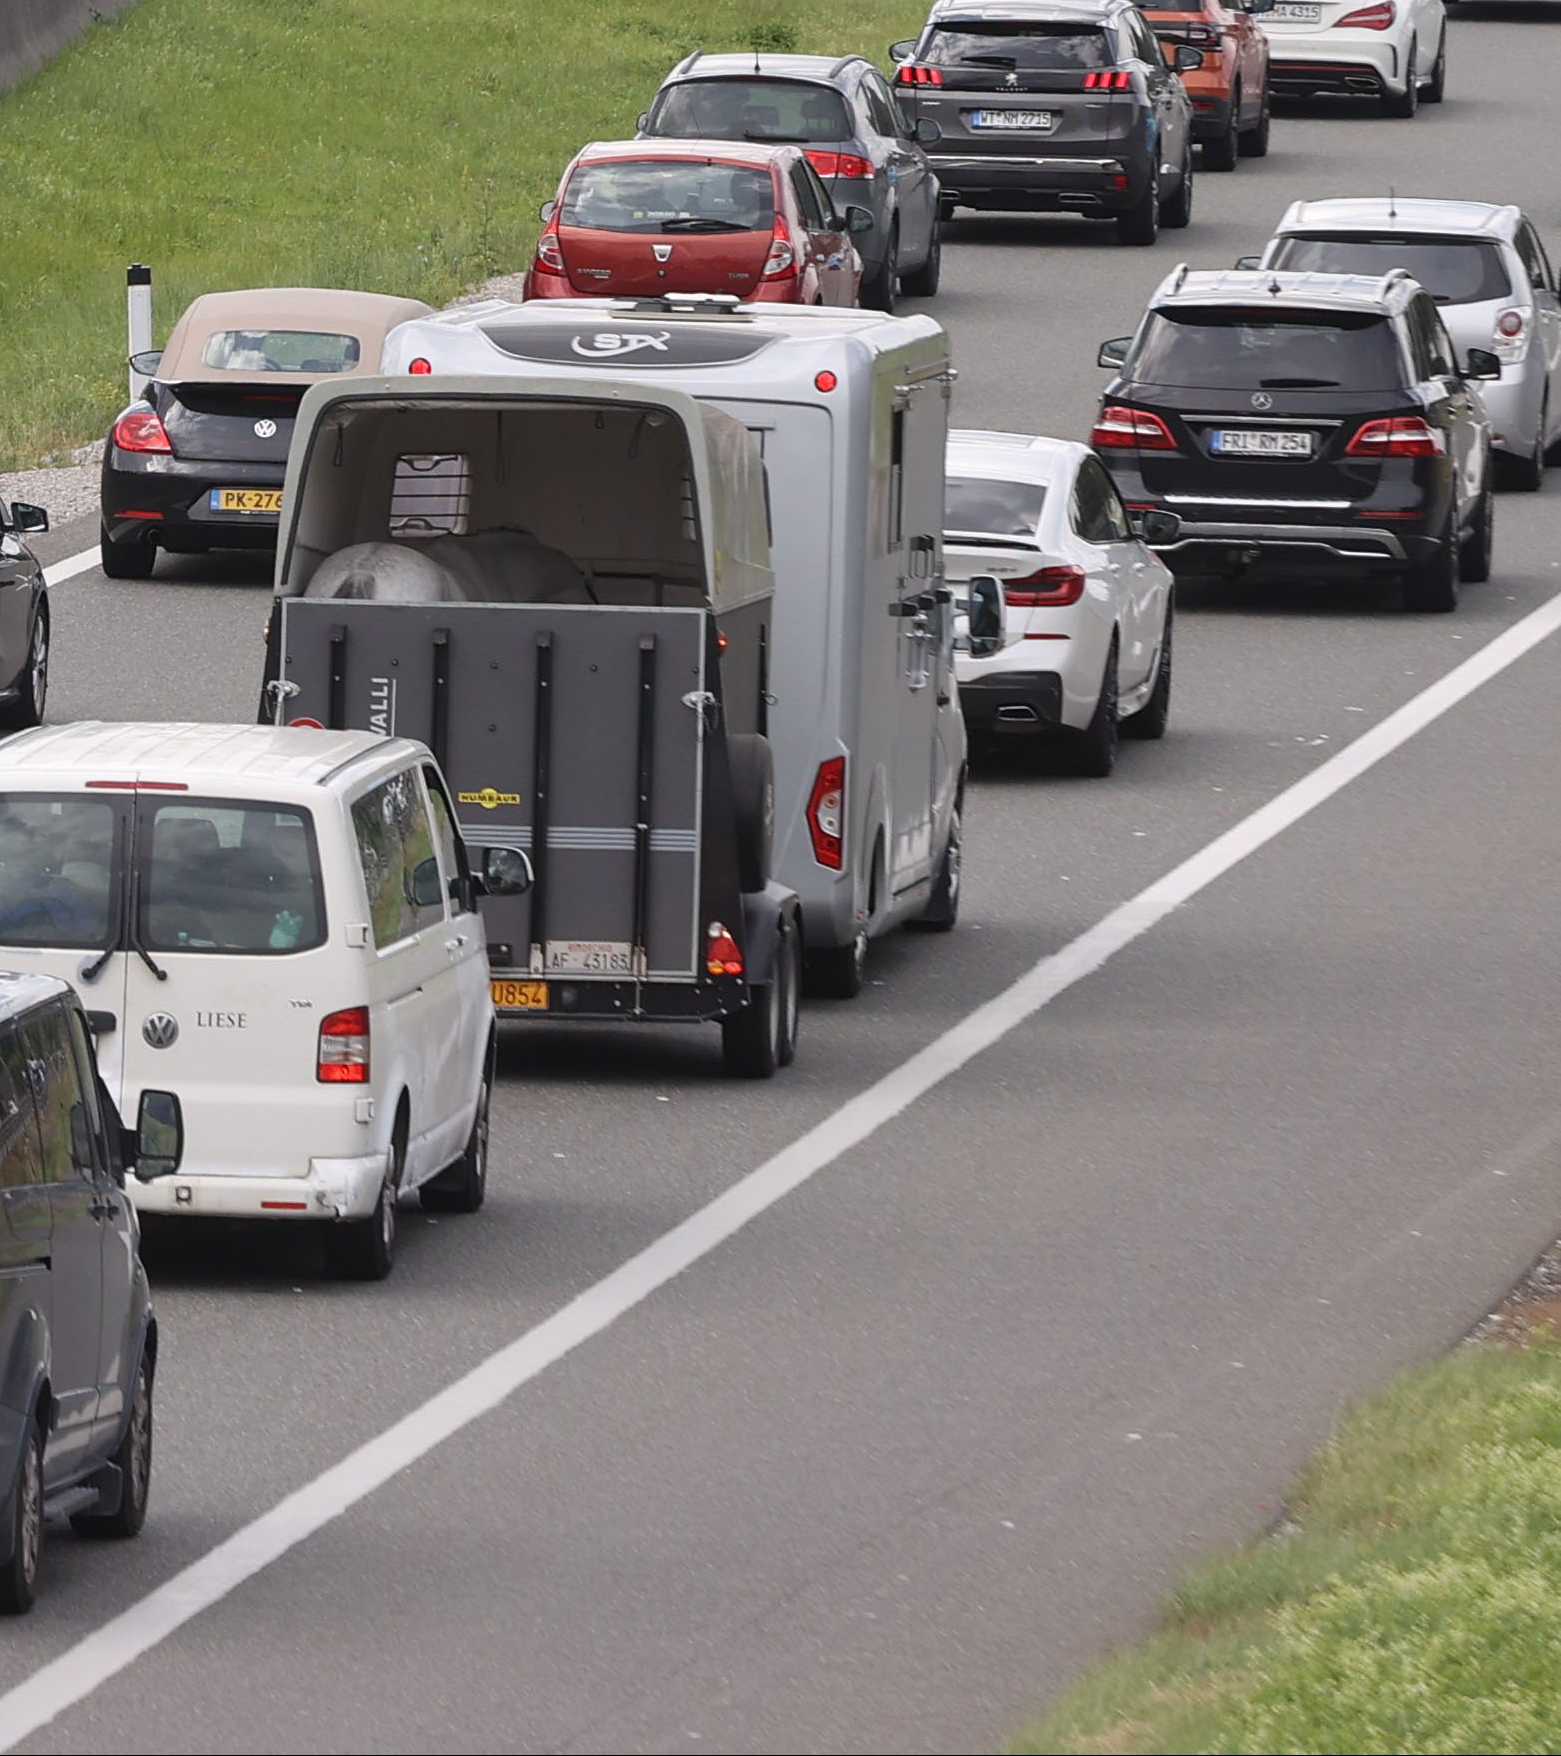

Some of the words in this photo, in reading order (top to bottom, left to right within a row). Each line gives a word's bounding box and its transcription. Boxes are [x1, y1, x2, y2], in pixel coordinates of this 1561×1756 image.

[1022, 113, 1050, 126] 2715
[1221, 435, 1248, 449] FRI
[1259, 435, 1279, 449] RM
[1281, 435, 1307, 451] 254
[461, 794, 518, 803] HUMBAUR
[196, 1012, 248, 1029] LIESE
